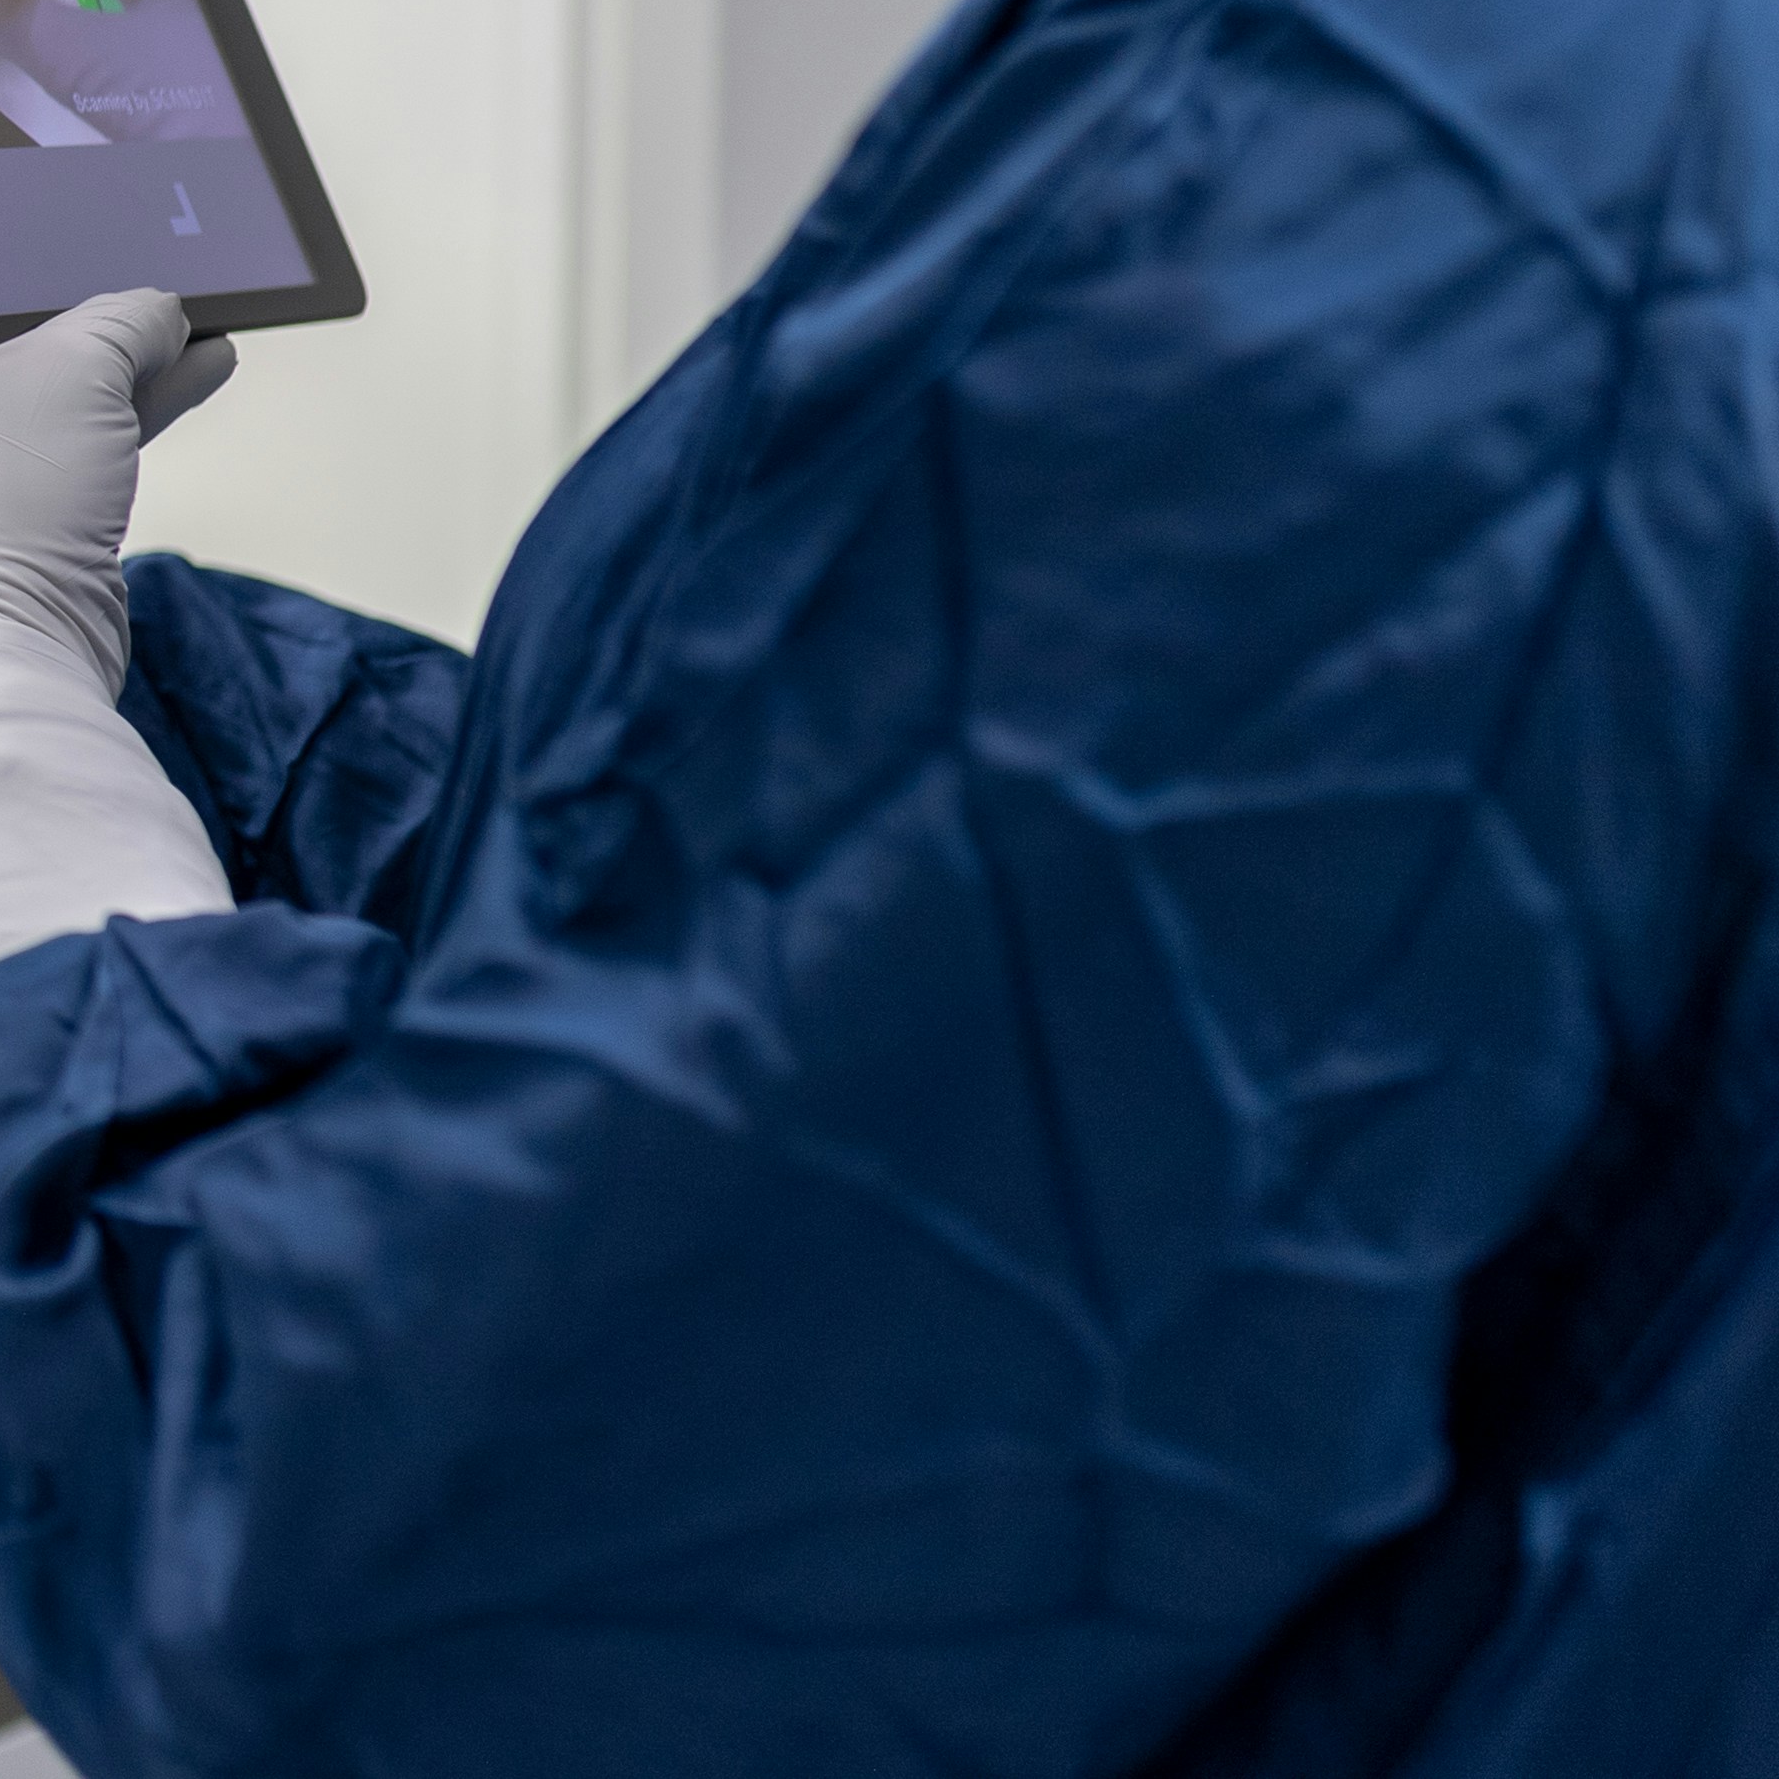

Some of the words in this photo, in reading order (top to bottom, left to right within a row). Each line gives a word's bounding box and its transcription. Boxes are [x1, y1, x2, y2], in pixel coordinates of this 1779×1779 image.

[73, 92, 133, 116] Scanning
[131, 91, 150, 115] by
[149, 85, 212, 110] SCANDIT
